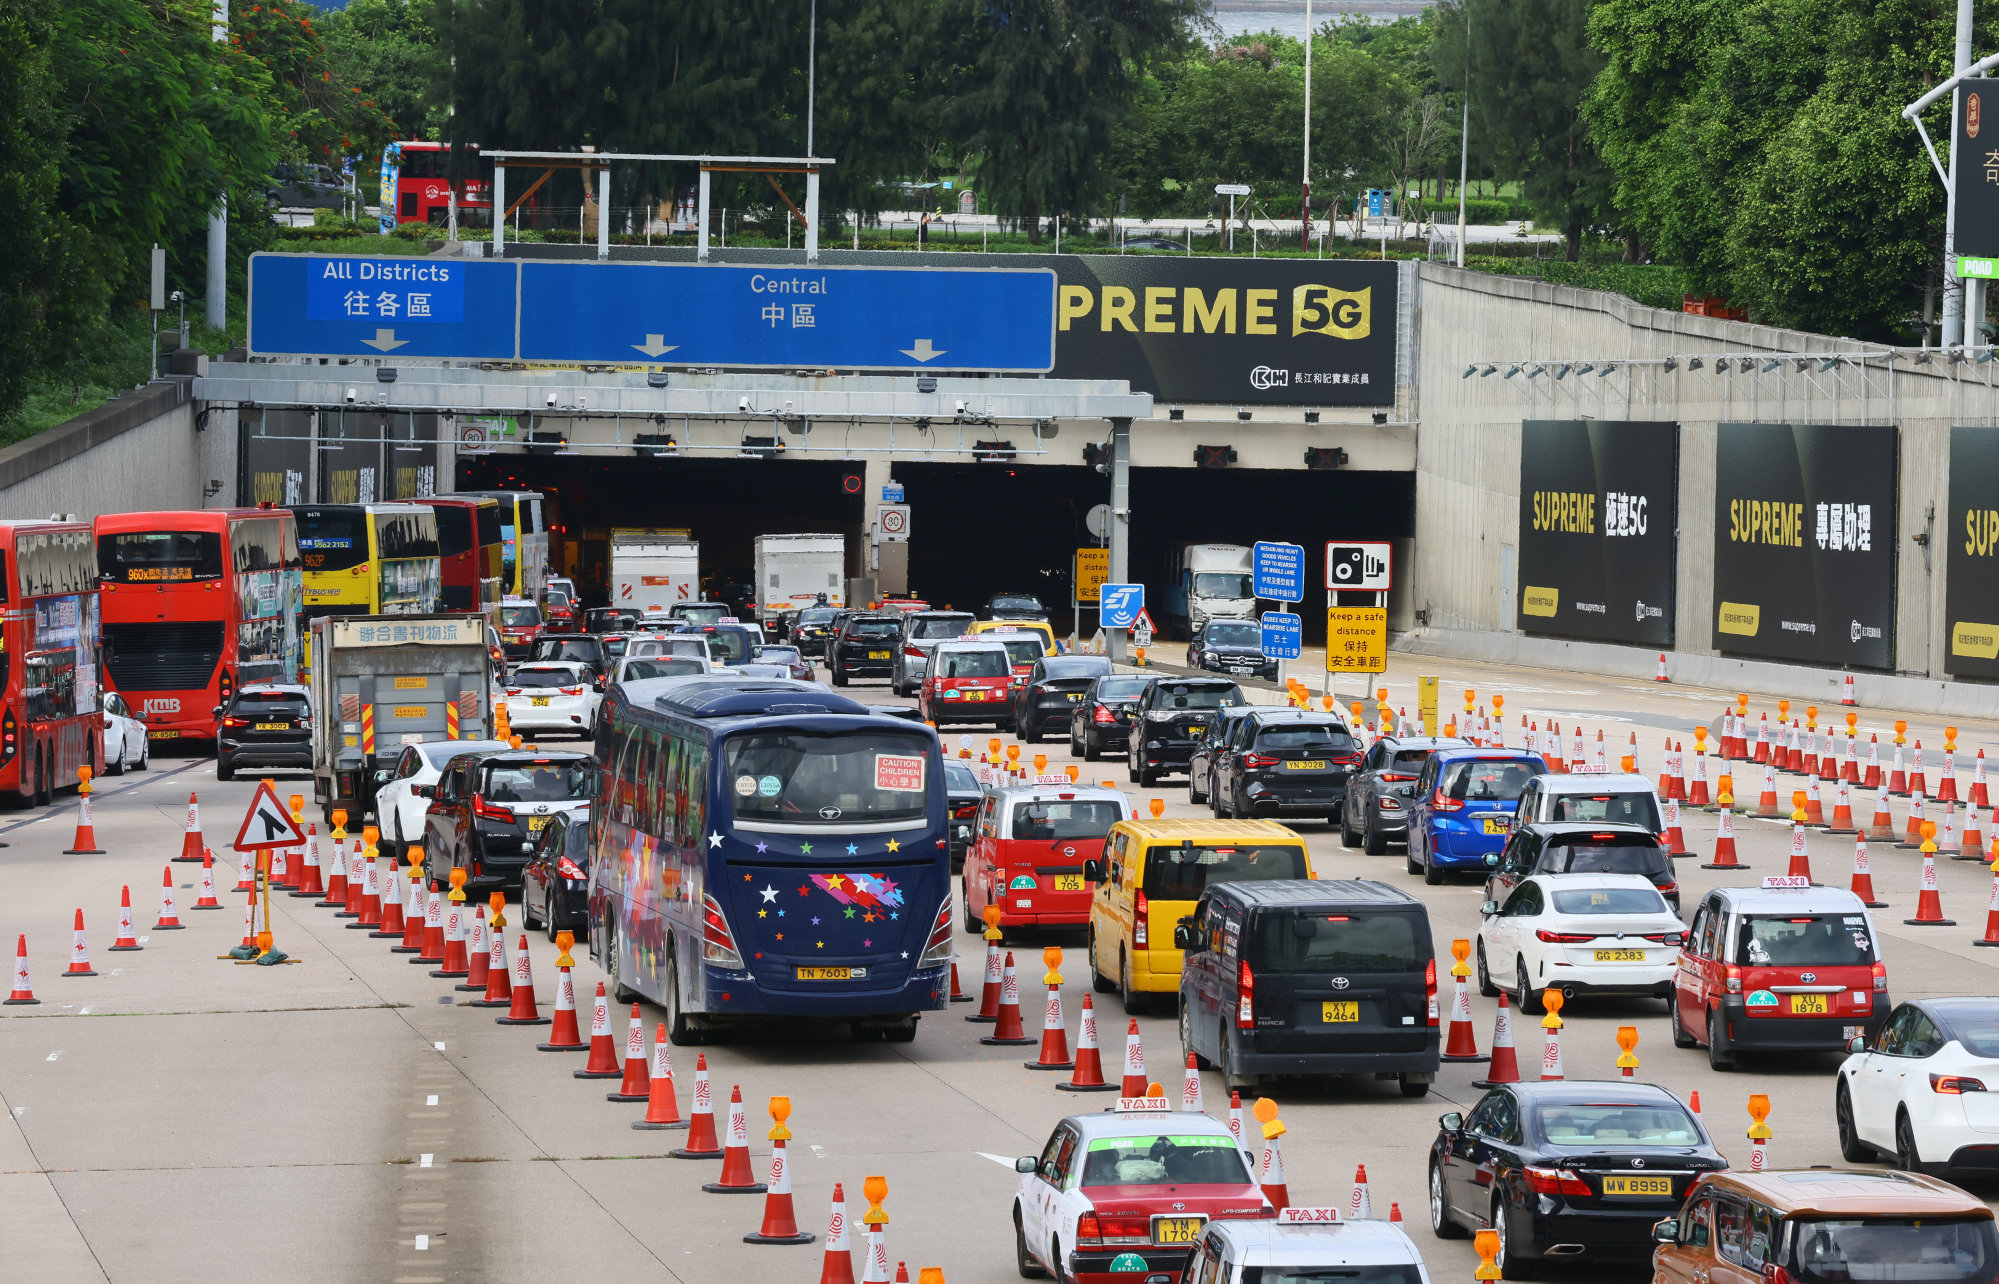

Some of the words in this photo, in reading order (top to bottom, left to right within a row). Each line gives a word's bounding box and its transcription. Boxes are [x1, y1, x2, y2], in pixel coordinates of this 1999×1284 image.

[323, 261, 352, 279] All
[360, 263, 450, 282] Districts
[1964, 260, 1993, 276] POAD
[751, 274, 828, 295] Central
[343, 290, 432, 317] 往各區
[1300, 288, 1363, 330] 5G
[761, 302, 816, 328] 中區
[1533, 491, 1595, 534] SUPREME
[1605, 492, 1647, 537] 極速5G
[887, 516, 899, 527] 80
[1730, 499, 1803, 548] SUPREME
[1816, 502, 1871, 551] 專屬助理
[332, 541, 349, 549] 2152
[1079, 552, 1098, 560] Keep
[1277, 554, 1297, 562] VEHICLES
[1091, 576, 1109, 584] 保持
[1080, 587, 1100, 597] 安全
[1330, 613, 1353, 621] Keep
[1364, 613, 1385, 621] safe
[1263, 624, 1286, 632] NEARSIDE
[1336, 627, 1376, 635] distance
[360, 625, 458, 642] 聯合書刊物流
[1273, 635, 1288, 644] 巴士
[1344, 641, 1368, 652] 保持
[1331, 656, 1381, 667] 安全車距
[144, 699, 180, 713] KMB
[882, 759, 918, 768] CAUTION
[1302, 761, 1324, 769] 3028
[880, 767, 920, 776] CHILDREN
[880, 777, 919, 789] 小心學童
[1037, 775, 1069, 783] TAXI
[536, 815, 548, 823] PE
[1063, 874, 1076, 883] VJ
[1768, 877, 1805, 886] TAXI
[1061, 882, 1080, 890] 705
[1843, 917, 1864, 926] MARVEL
[1596, 951, 1611, 960] GG
[1615, 951, 1643, 960] 2383
[800, 969, 815, 978] TN
[820, 969, 848, 978] 7603
[1801, 995, 1817, 1003] XU
[1333, 1003, 1347, 1011] XY
[1795, 1004, 1823, 1013] 1878
[1325, 1012, 1356, 1020] 9464
[1121, 1098, 1166, 1109] TAXI
[1606, 1180, 1625, 1192] MW
[1630, 1180, 1668, 1192] 8999
[1286, 1209, 1336, 1220] TAXI
[1171, 1219, 1189, 1230] YM
[1164, 1230, 1198, 1242] 1706
